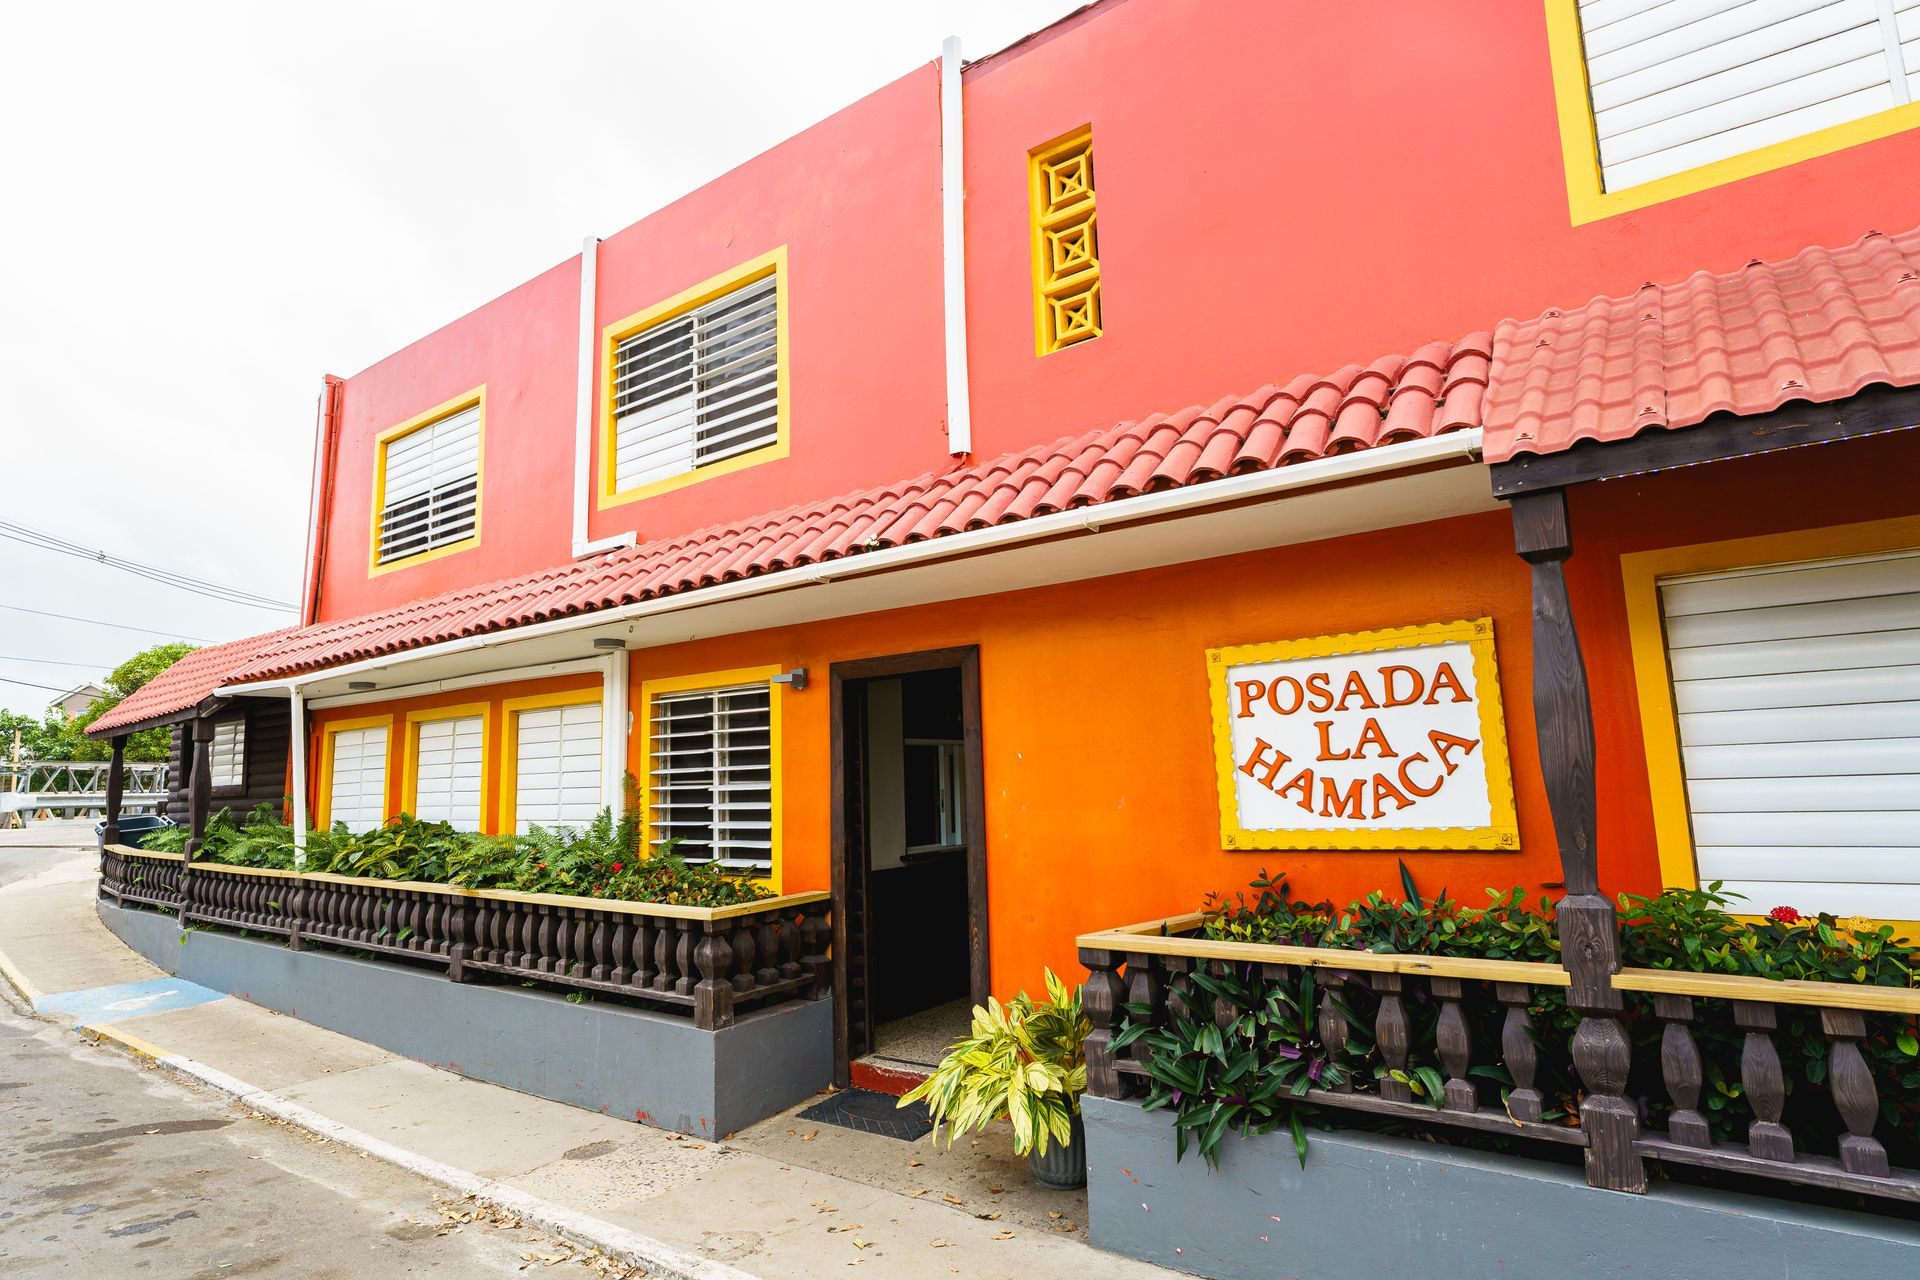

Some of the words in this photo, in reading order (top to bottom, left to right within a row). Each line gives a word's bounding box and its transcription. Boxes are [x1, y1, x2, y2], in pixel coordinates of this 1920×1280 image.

[1234, 662, 1472, 719] POSADA
[1314, 718, 1398, 761] LA
[1238, 730, 1480, 820] HAMACA
